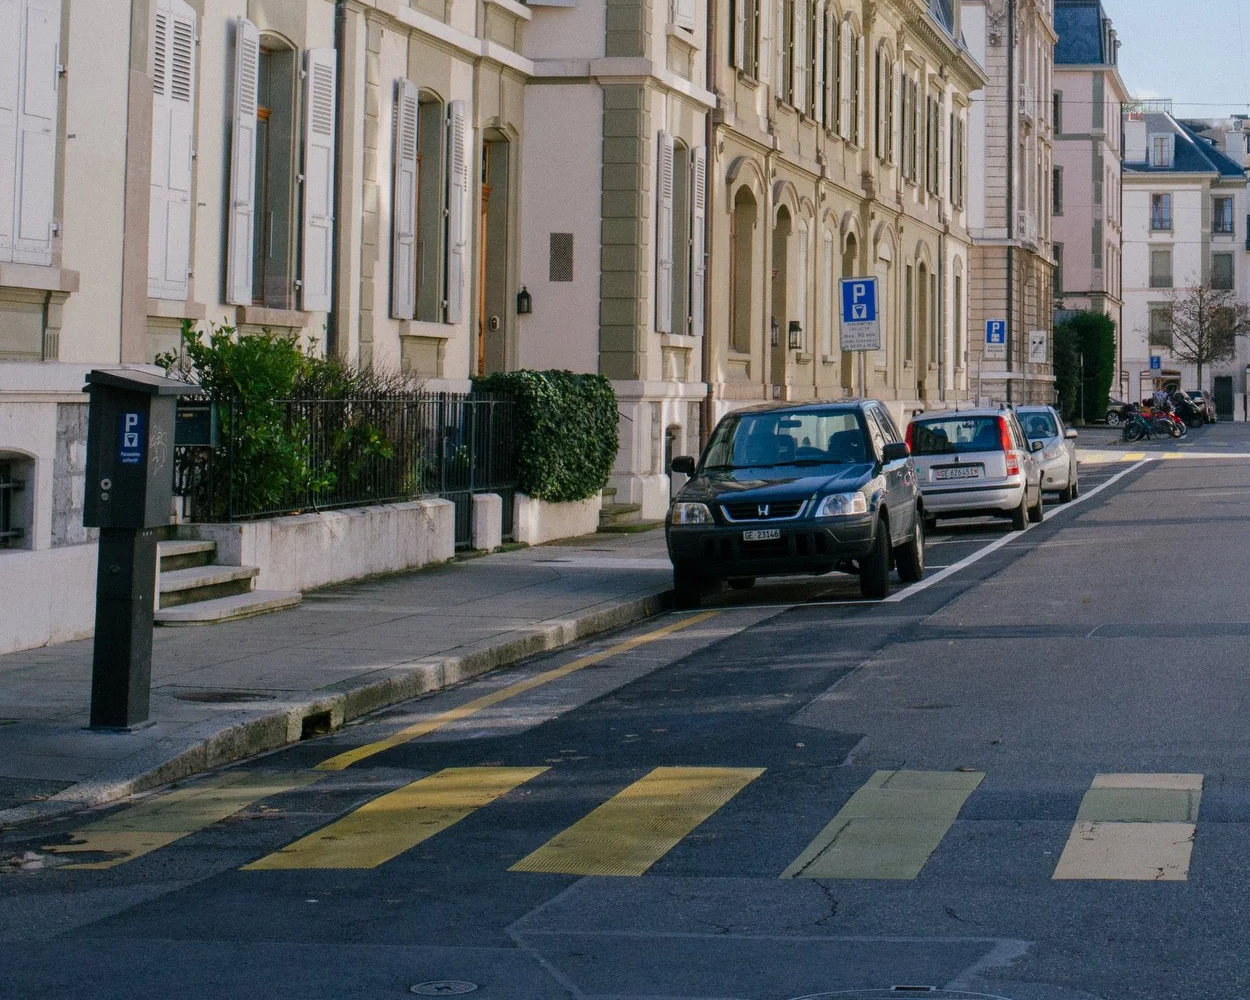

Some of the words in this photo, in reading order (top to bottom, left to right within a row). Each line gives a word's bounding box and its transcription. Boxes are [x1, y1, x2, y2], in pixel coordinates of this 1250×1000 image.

[853, 284, 866, 304] P
[992, 322, 1000, 333] P
[125, 413, 138, 432] P
